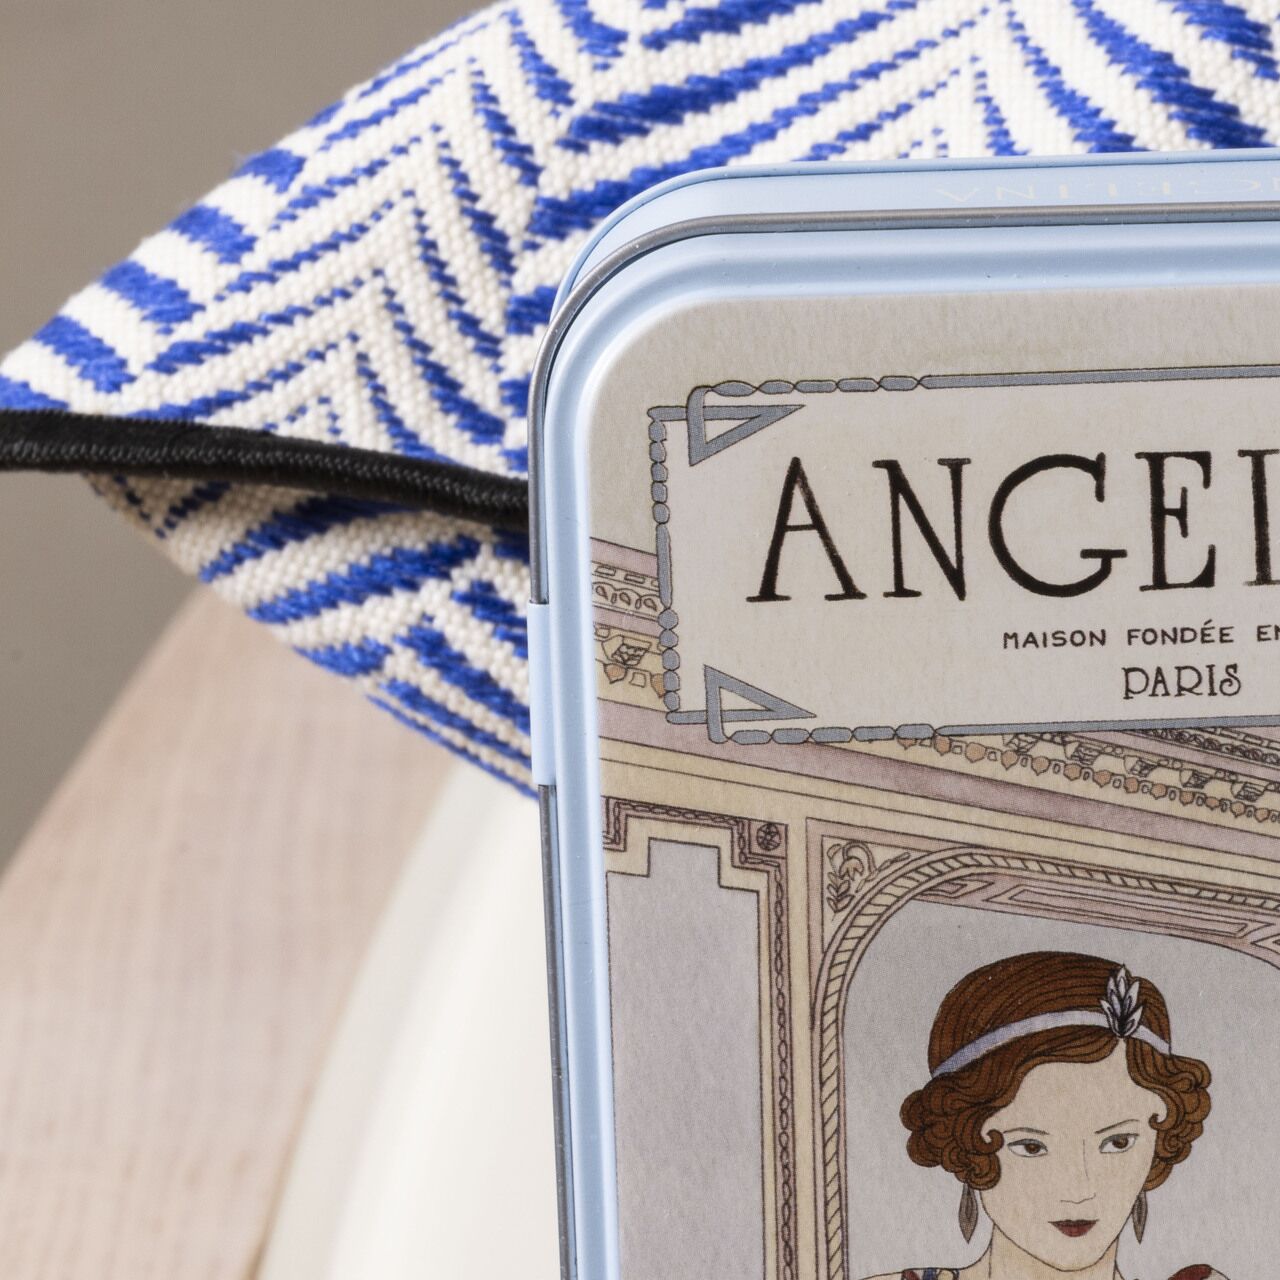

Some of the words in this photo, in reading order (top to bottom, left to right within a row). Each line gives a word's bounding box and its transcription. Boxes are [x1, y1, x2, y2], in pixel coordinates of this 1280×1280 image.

[1002, 628, 1107, 650] MAISON
[1127, 618, 1235, 646] FONDÉE
[1121, 663, 1242, 700] PARIS
